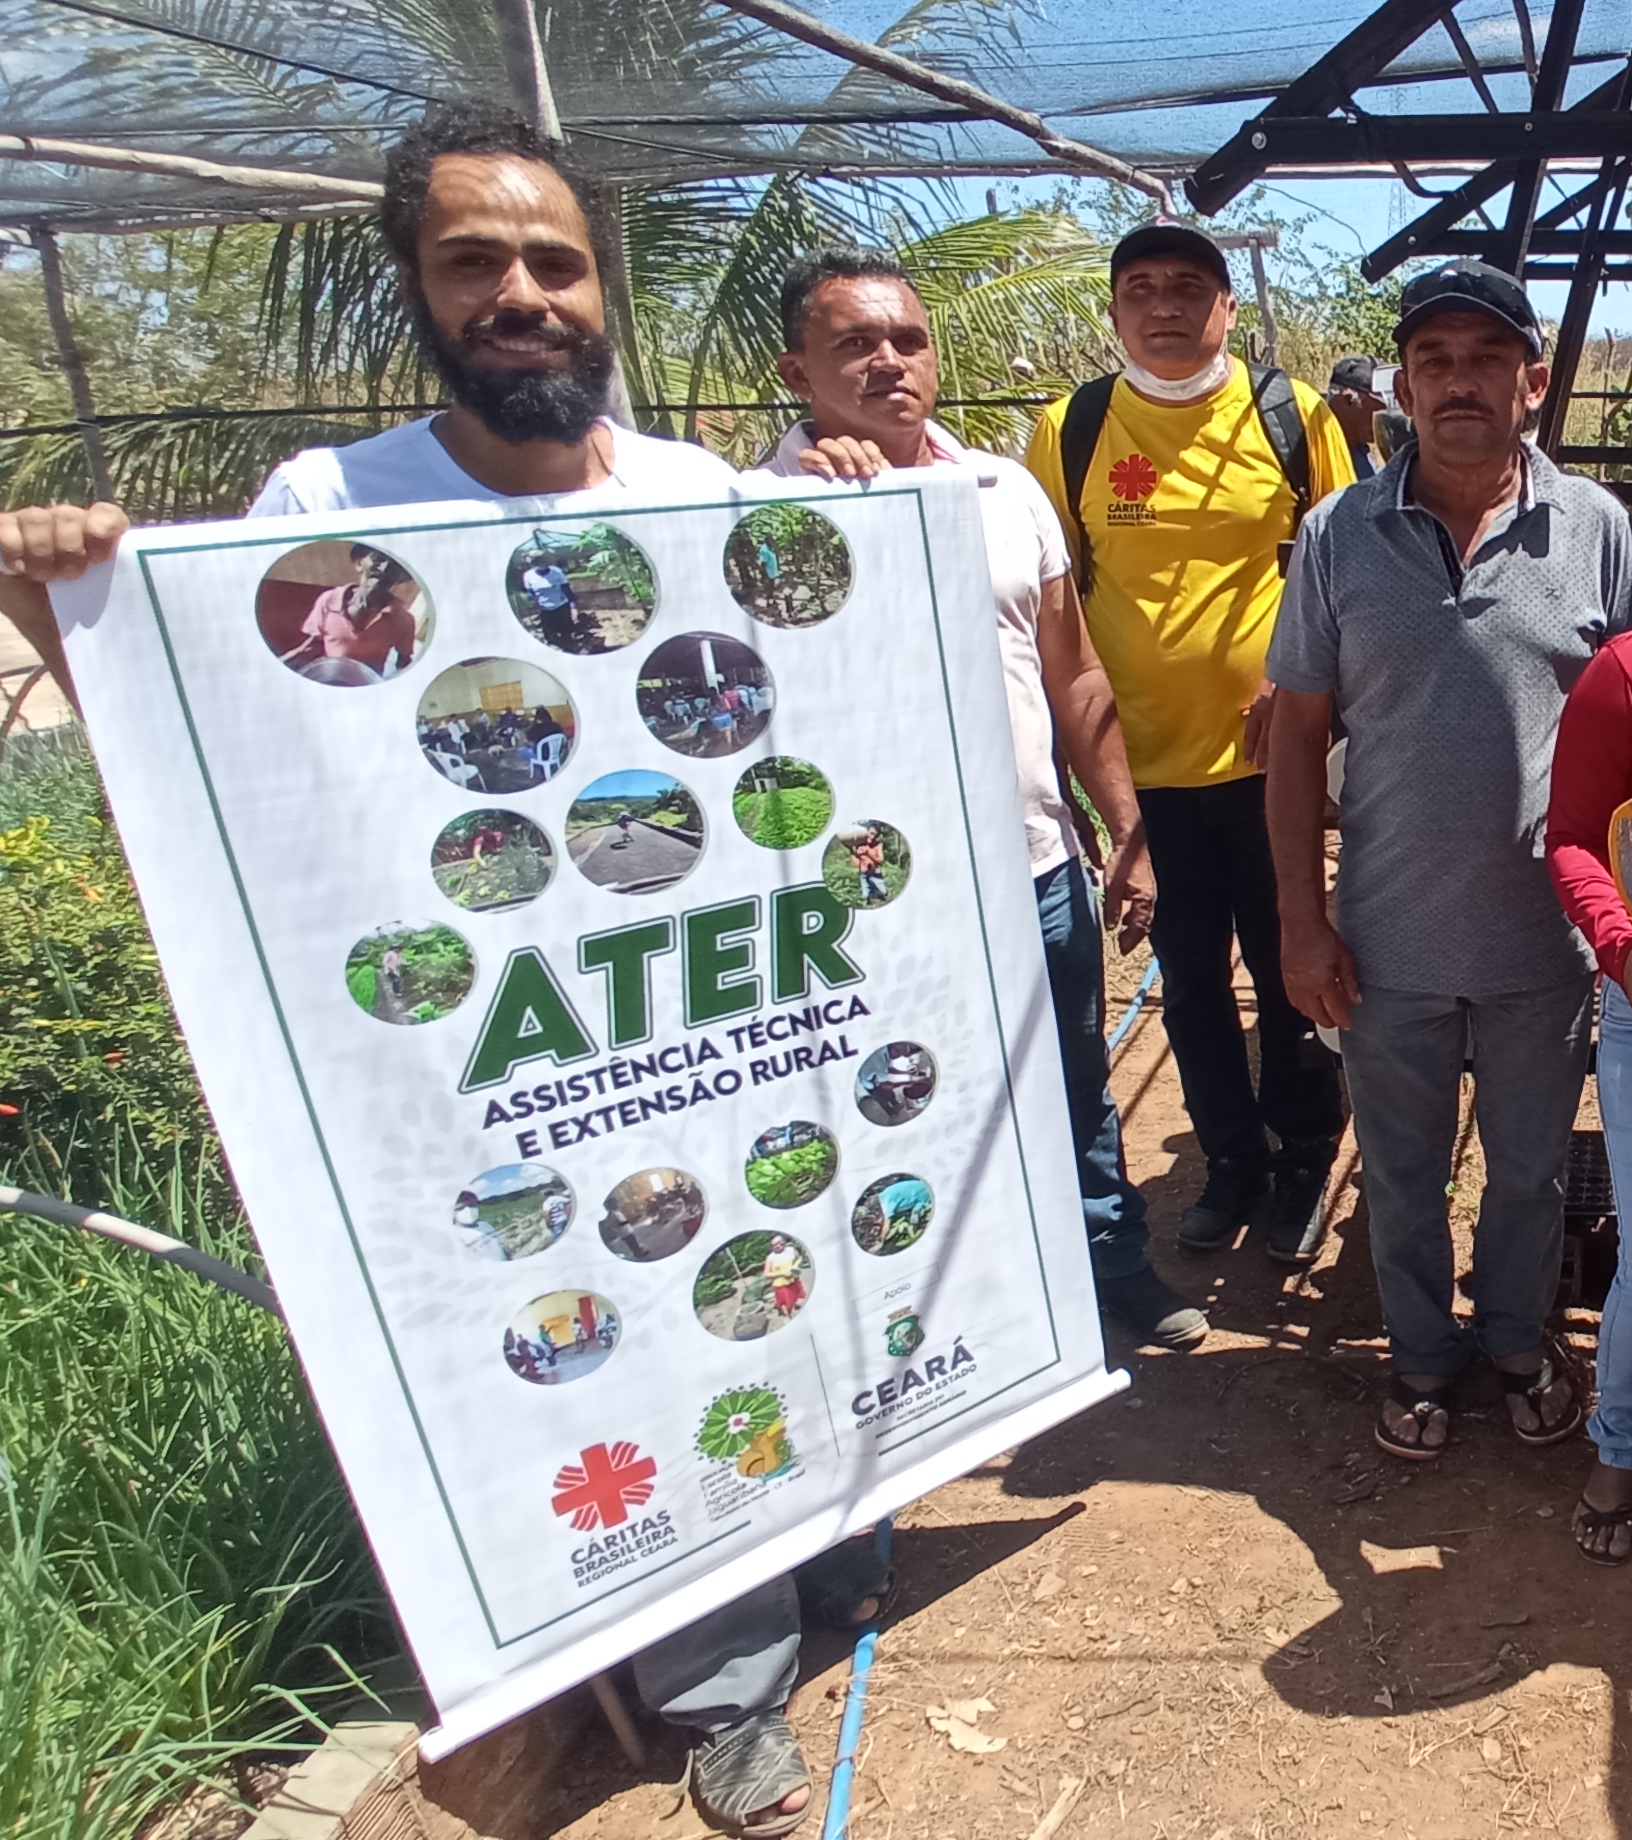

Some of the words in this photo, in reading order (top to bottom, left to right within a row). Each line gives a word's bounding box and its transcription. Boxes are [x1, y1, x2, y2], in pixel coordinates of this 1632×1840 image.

[1107, 500, 1157, 513] CÁRITAS
[457, 880, 867, 1095] ATER
[481, 1035, 724, 1131] ASSISTÊNCIA
[726, 994, 871, 1055] TÉCNICA
[515, 1130, 542, 1159] E
[547, 1070, 744, 1151] EXTENSÃO
[750, 1033, 859, 1087] RURAL
[884, 1283, 912, 1299] Apoio
[852, 1335, 975, 1416] CEARÁ
[856, 1397, 914, 1429] GOVERNO
[916, 1388, 933, 1401] DO
[935, 1363, 978, 1391] ESTADO
[571, 1510, 671, 1564] CÁRITAS
[573, 1525, 676, 1579] BRASILEIRA
[577, 1556, 638, 1588] REGIONAL
